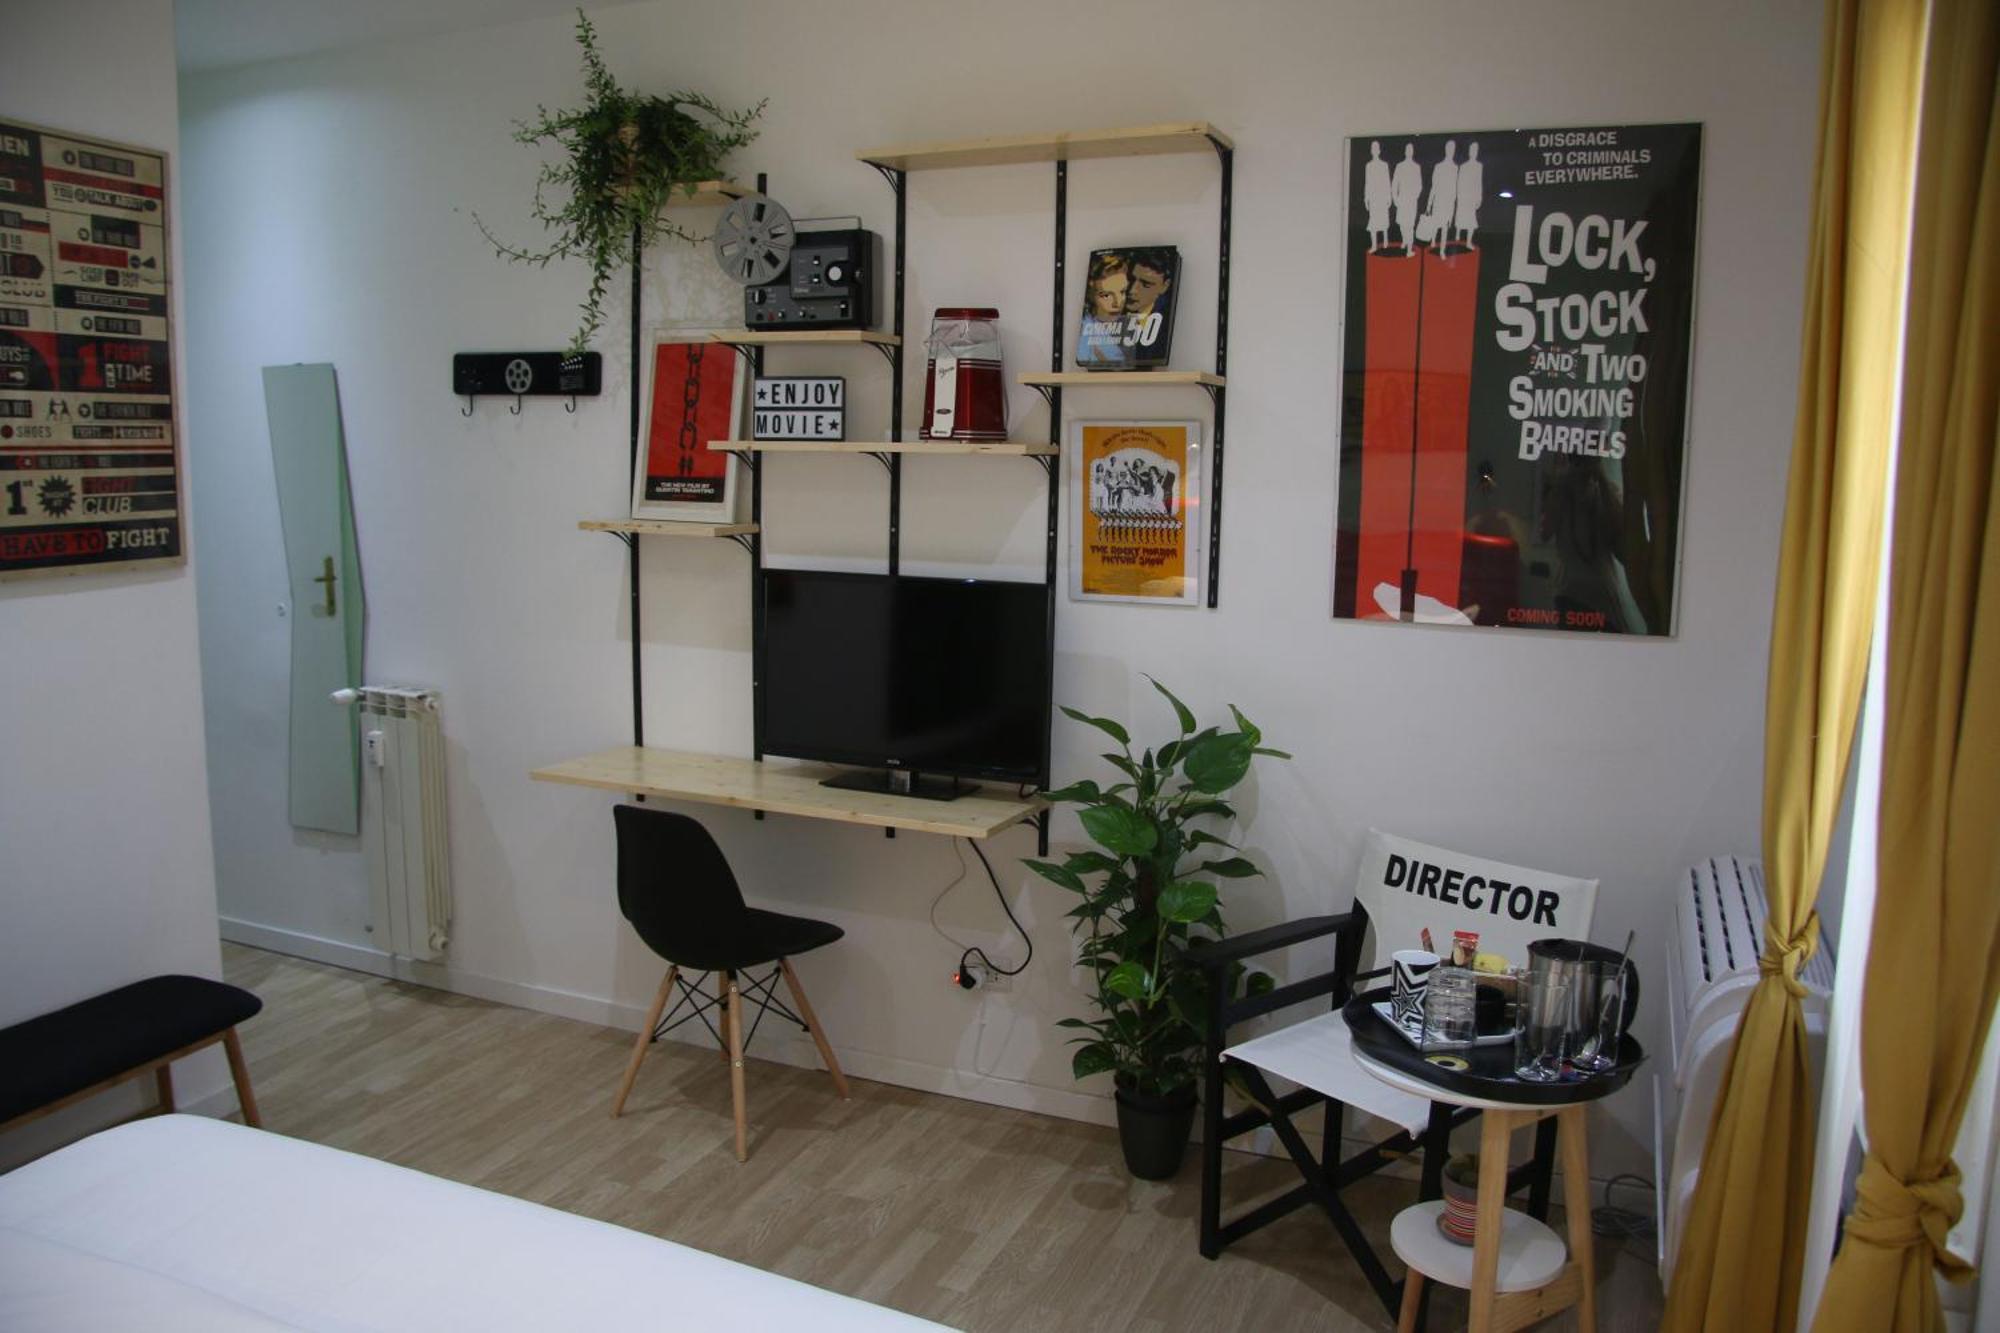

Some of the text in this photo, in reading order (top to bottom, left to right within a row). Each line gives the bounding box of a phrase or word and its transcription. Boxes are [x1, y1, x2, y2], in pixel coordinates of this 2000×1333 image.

[1528, 131, 1617, 148] A DISGRACE
[1543, 149, 1651, 166] TO CRIMINALS
[1525, 165, 1639, 186] EVERYWHERE.
[1508, 204, 1657, 284] LOCK,
[1495, 282, 1650, 352] STOCK
[1123, 312, 1163, 347] 50
[117, 363, 153, 383] TIME
[1534, 343, 1647, 384] AND TWO
[771, 383, 841, 405] ENJOY
[1508, 375, 1634, 420] SMOKING
[15, 425, 52, 439] SHOES
[756, 414, 824, 435] MOVIE
[1518, 421, 1627, 461] BARRELS
[84, 497, 131, 514] CLUB
[1, 527, 170, 557] HAVE TO FIGHT
[1089, 545, 1108, 554] THE
[1507, 608, 1606, 627] COMING SOON
[1384, 854, 1560, 927] DIRECTOR
